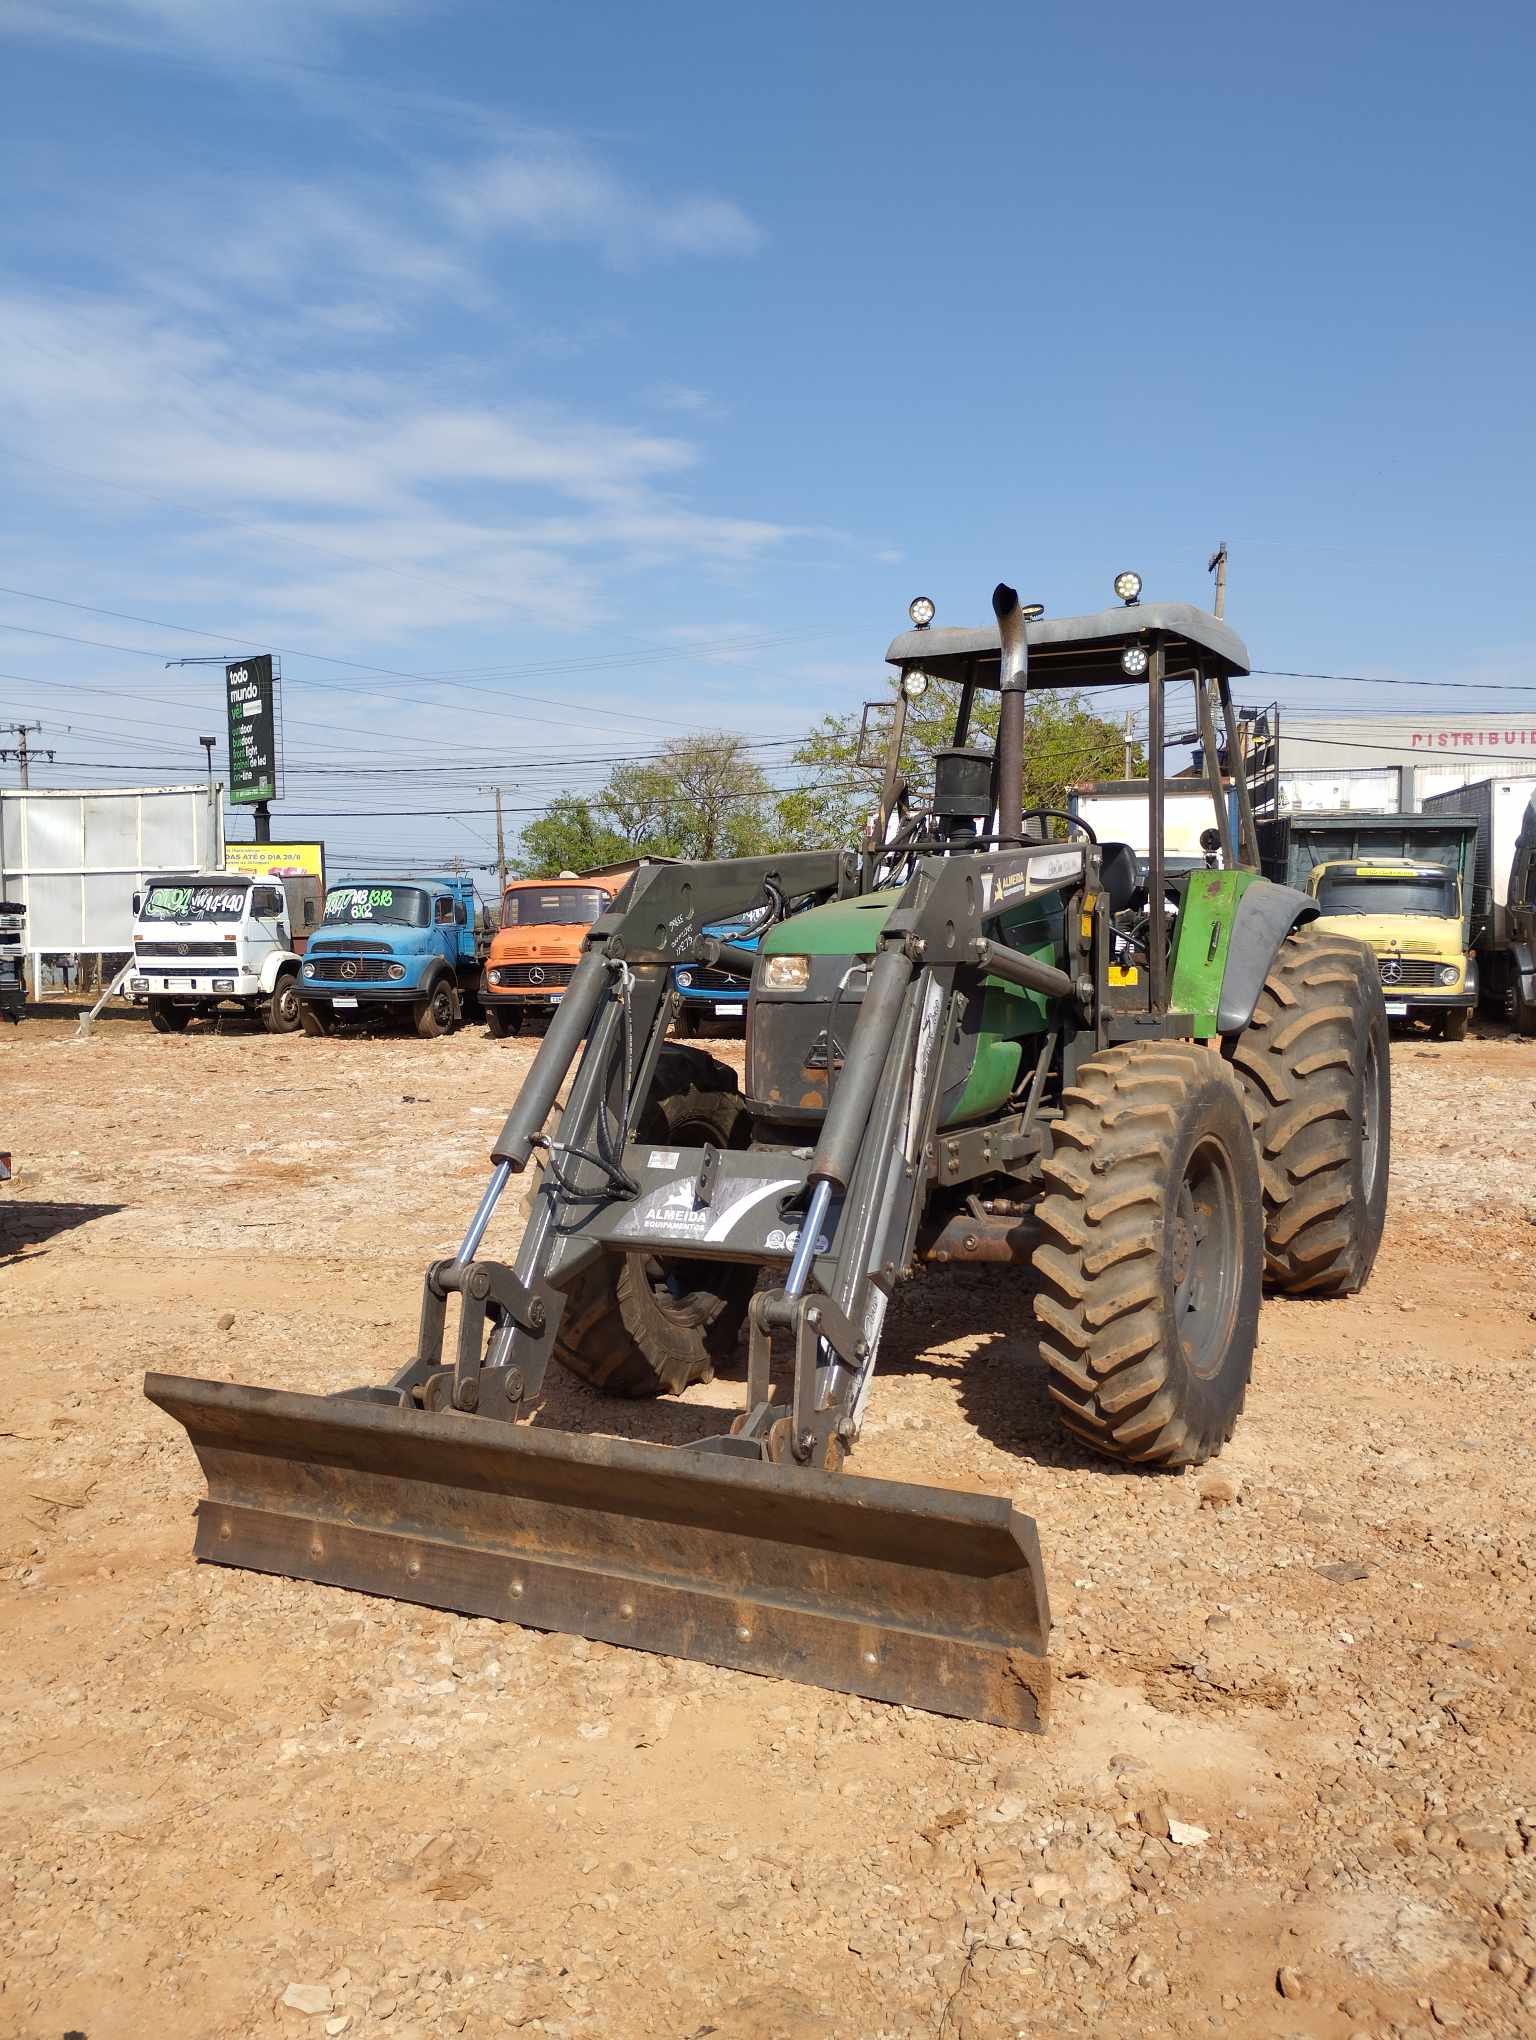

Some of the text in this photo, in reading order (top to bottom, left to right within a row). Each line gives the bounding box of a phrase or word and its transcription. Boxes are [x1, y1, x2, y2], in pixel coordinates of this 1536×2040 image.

[230, 666, 248, 685] todo
[231, 682, 258, 702] mundo
[246, 745, 257, 758] light
[250, 757, 258, 768] de
[258, 754, 267, 766] led
[646, 1209, 706, 1222] ALMEIDA
